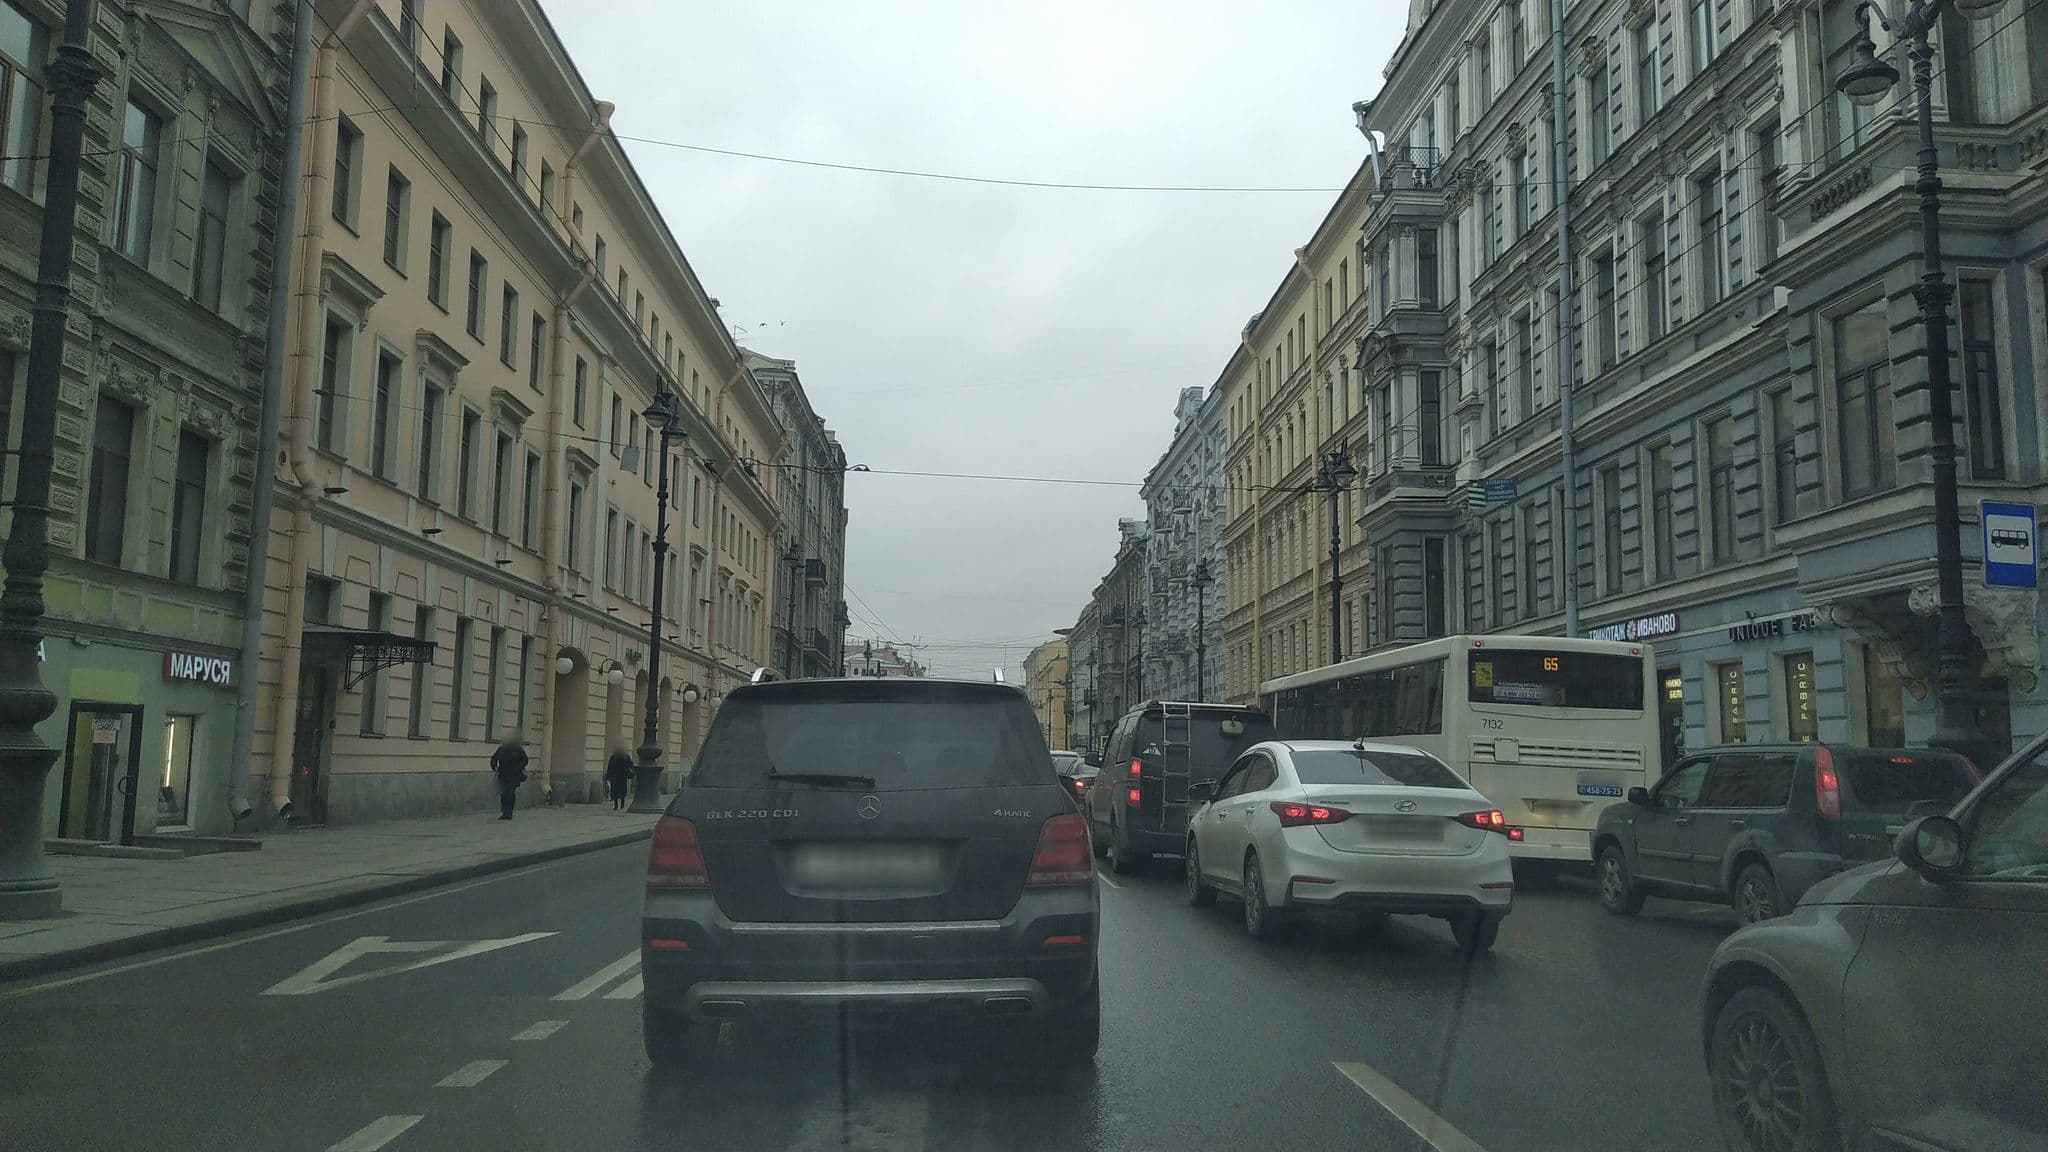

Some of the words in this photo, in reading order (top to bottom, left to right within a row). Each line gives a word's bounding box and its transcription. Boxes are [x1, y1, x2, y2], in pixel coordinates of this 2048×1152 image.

[1589, 623, 1626, 641] ТРИКОТАЖ
[1637, 613, 1676, 637] ИВАНОВО
[1728, 620, 1778, 641] UNIQUE
[170, 653, 231, 684] МАРУСЯ
[1543, 657, 1559, 672] 65
[1482, 718, 1504, 730] 7132
[706, 810, 732, 820] GLK
[738, 810, 768, 819] 220
[773, 809, 799, 818] CDI
